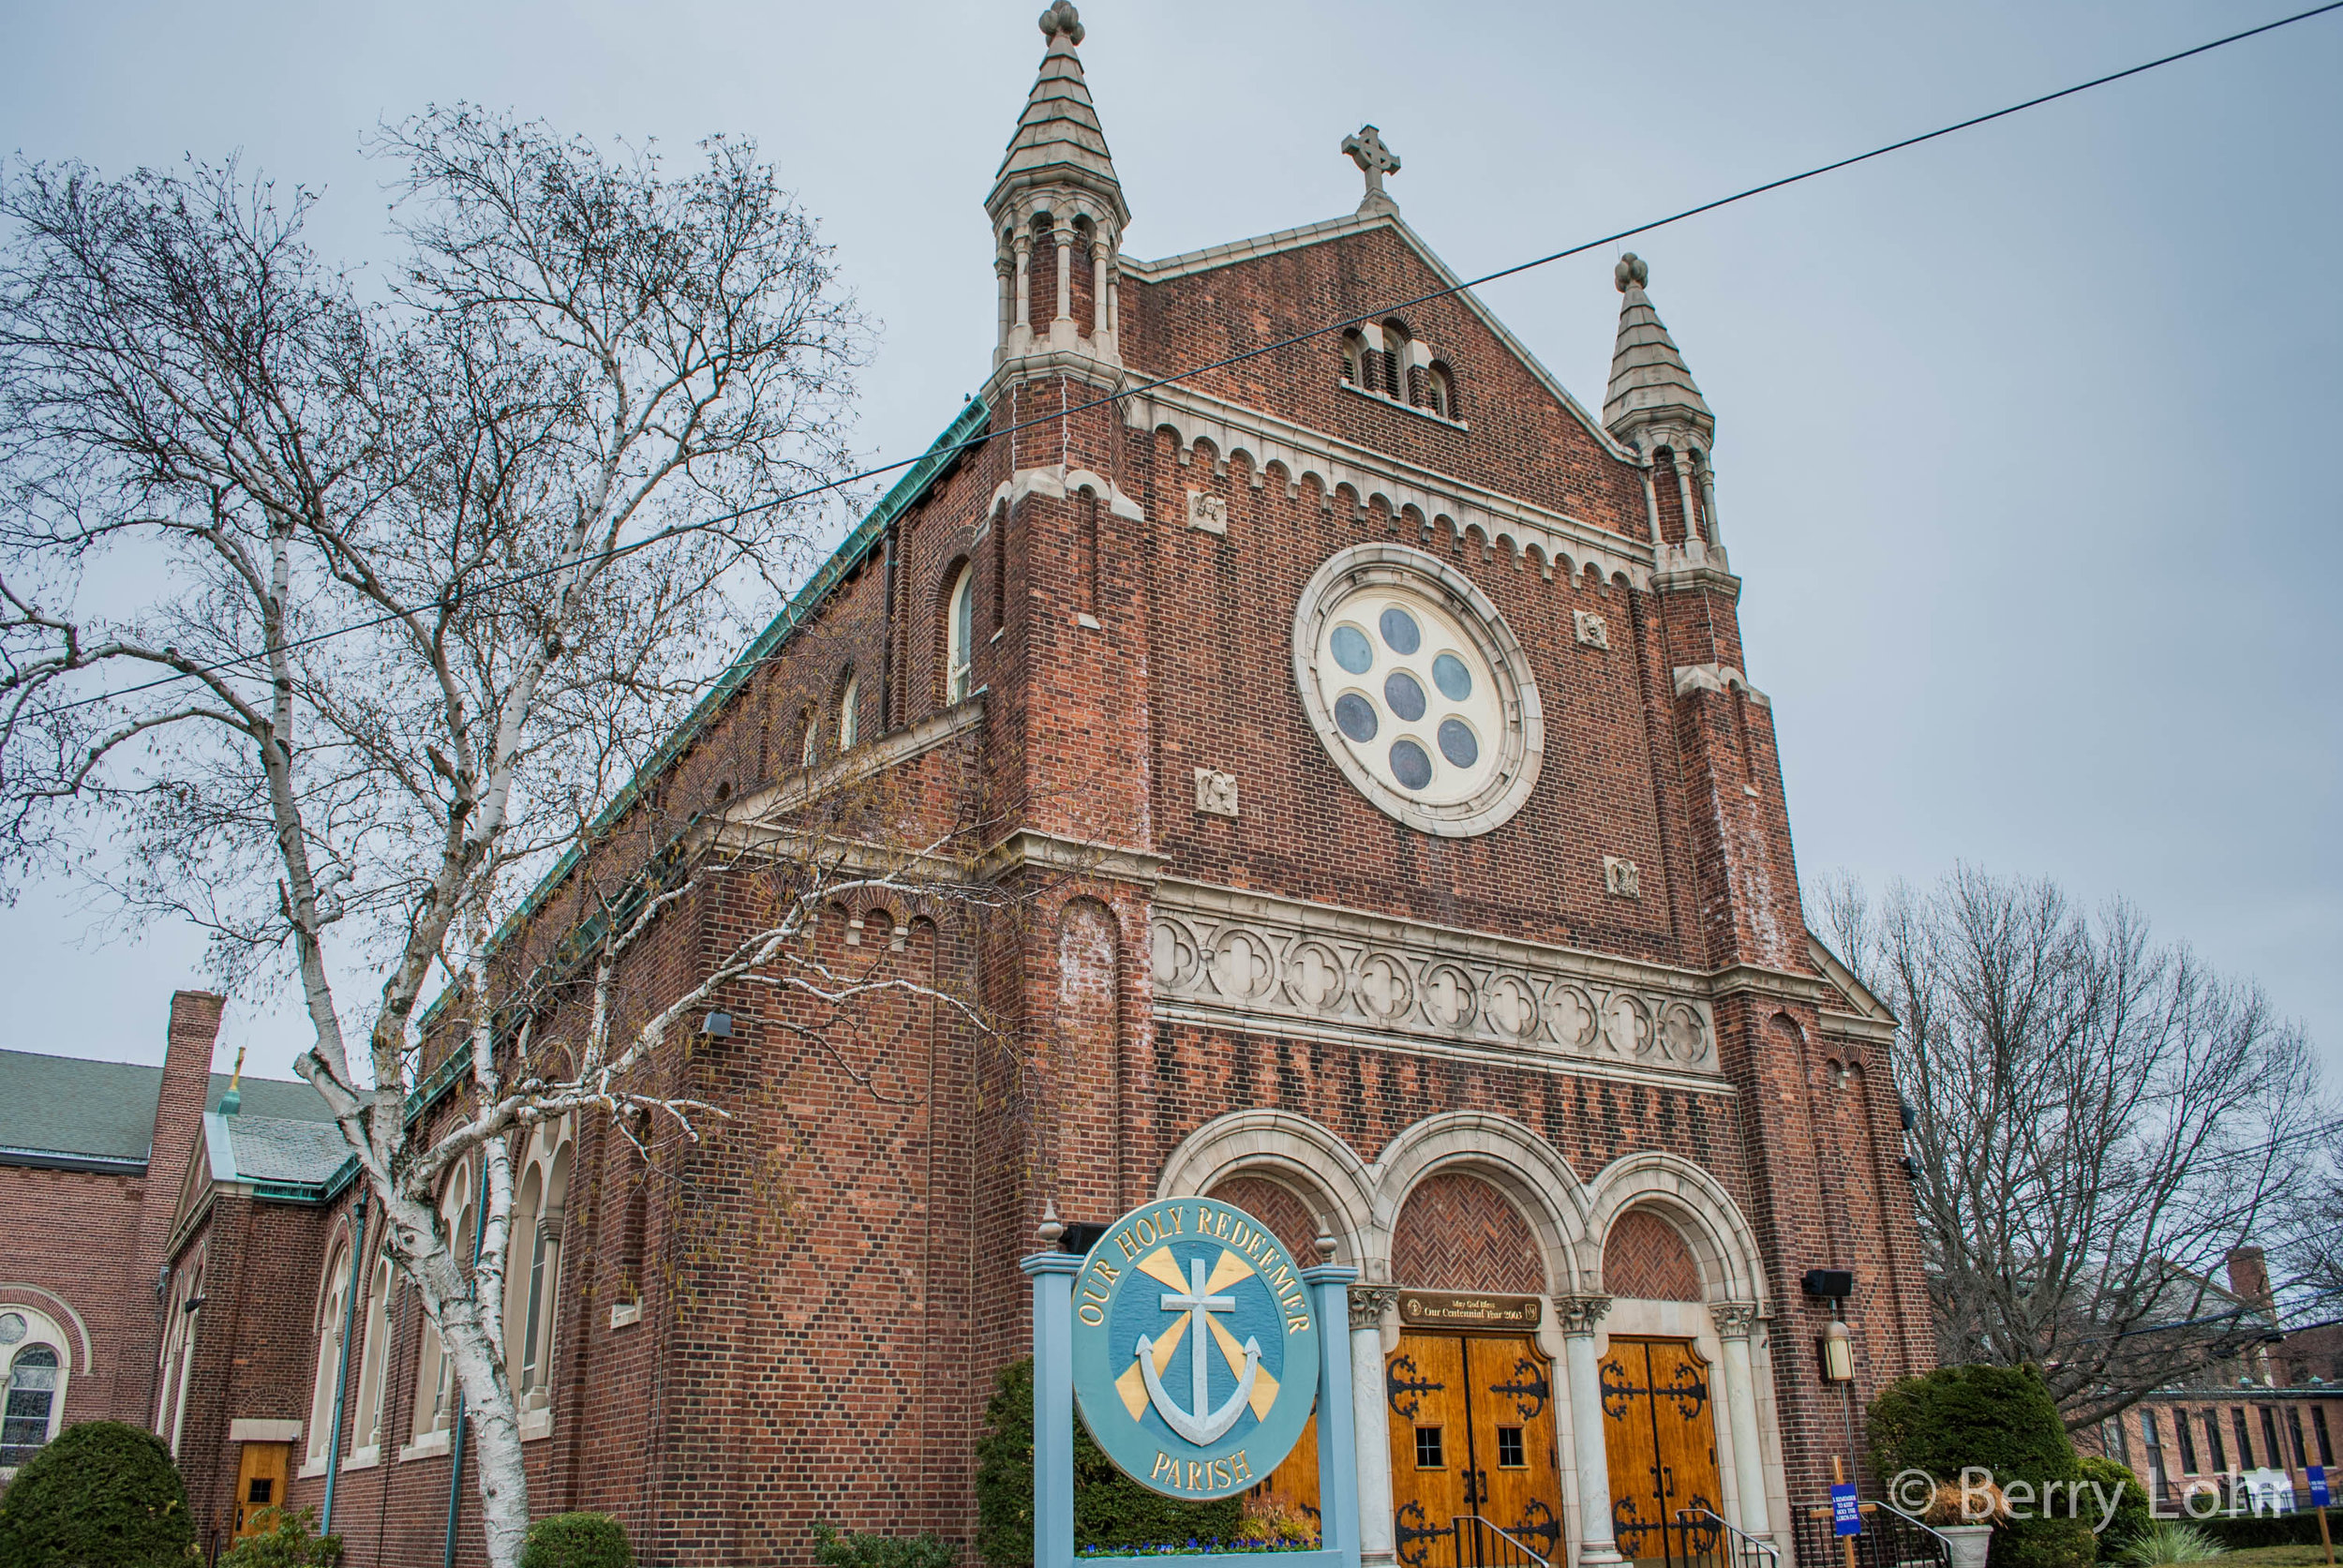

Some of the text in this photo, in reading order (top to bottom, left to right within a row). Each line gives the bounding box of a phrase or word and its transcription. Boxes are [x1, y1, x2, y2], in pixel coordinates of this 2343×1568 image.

[1078, 1205, 1311, 1336] OUR HOLY REDEEMER
[1425, 1307, 1440, 1317] Our
[1442, 1307, 1485, 1319] Centennial
[1485, 1309, 1502, 1320] Year
[1452, 1300, 1496, 1309] May God Bless
[1150, 1450, 1253, 1492] PARISH
